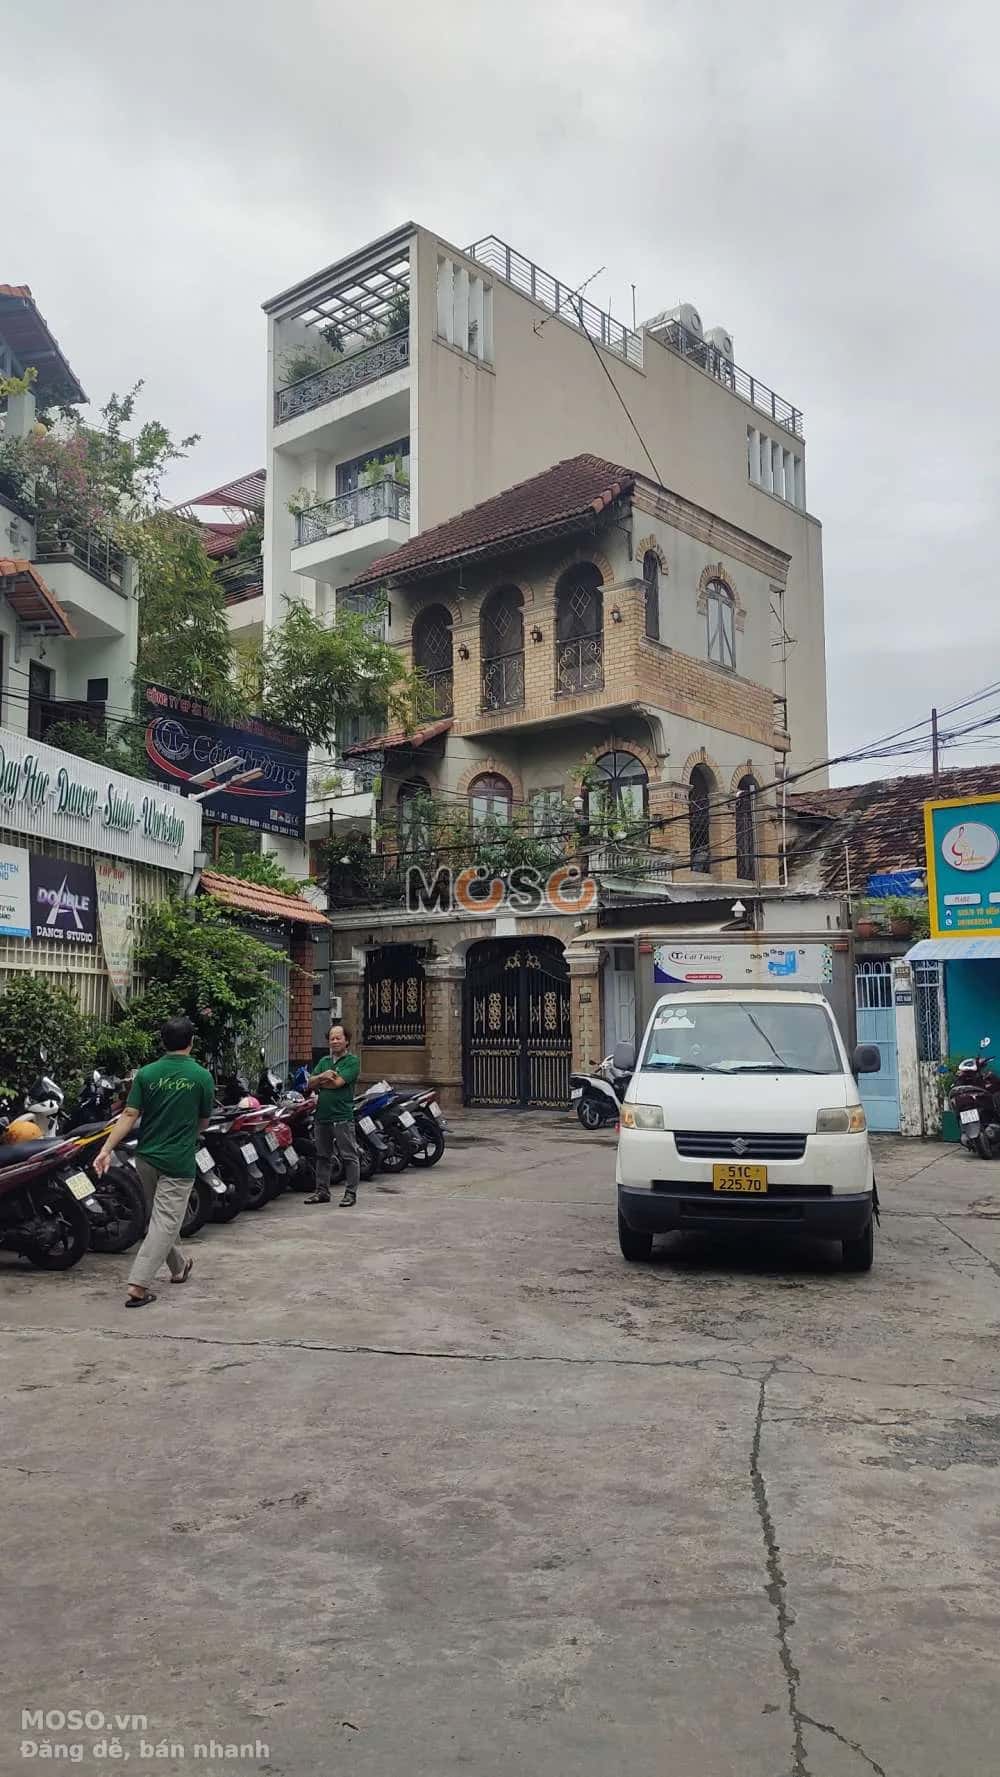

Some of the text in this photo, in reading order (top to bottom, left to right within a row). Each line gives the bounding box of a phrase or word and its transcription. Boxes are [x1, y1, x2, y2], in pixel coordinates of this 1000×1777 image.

[56, 767, 98, 818] Dancer
[37, 887, 90, 911] DOUBLE
[36, 926, 64, 939] DANCE
[66, 930, 93, 943] STUDIO
[728, 1166, 751, 1178] 51C
[720, 1178, 761, 1191] 225.70
